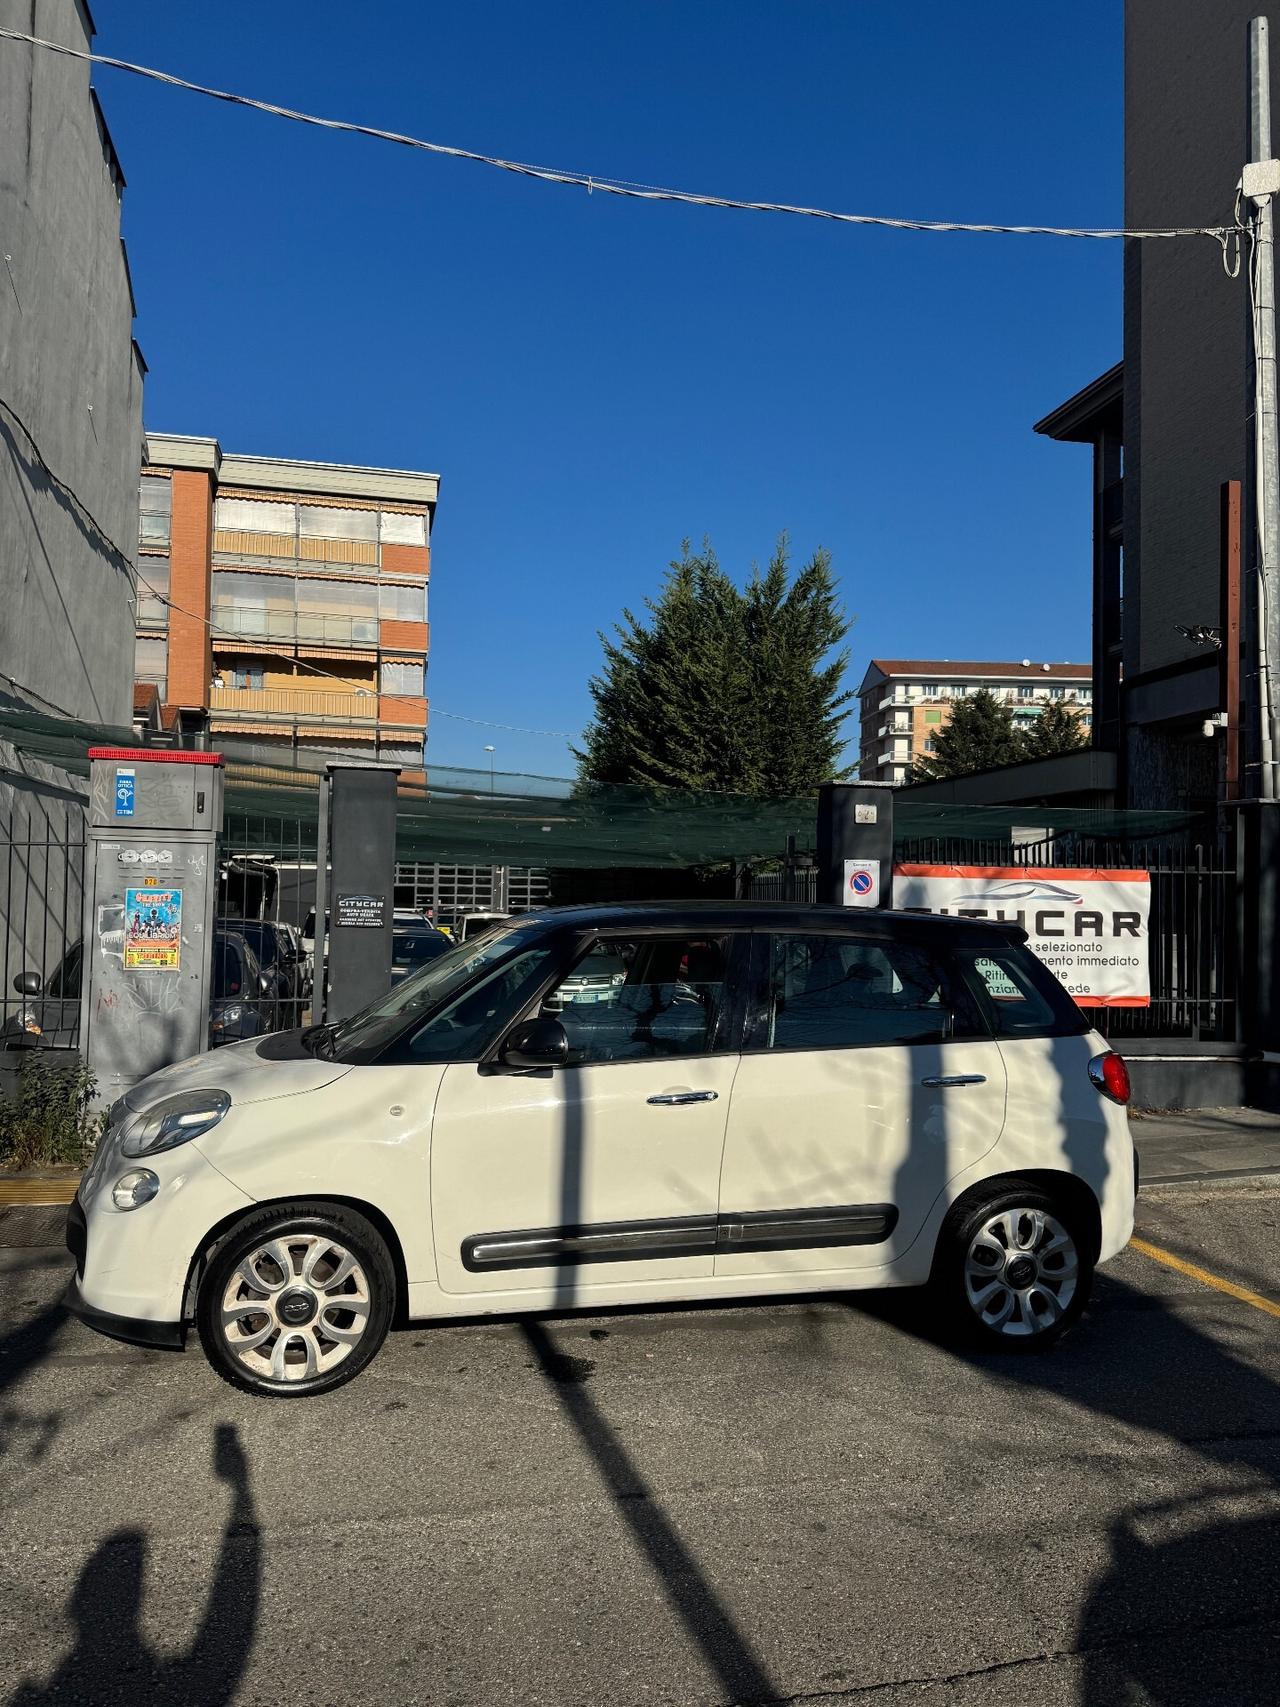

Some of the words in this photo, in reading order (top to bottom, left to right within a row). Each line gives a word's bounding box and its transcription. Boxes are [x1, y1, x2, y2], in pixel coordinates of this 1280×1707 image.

[339, 900, 384, 908] CITYCAR
[1035, 941, 1103, 952] selezionato
[1077, 955, 1140, 966] immediato
